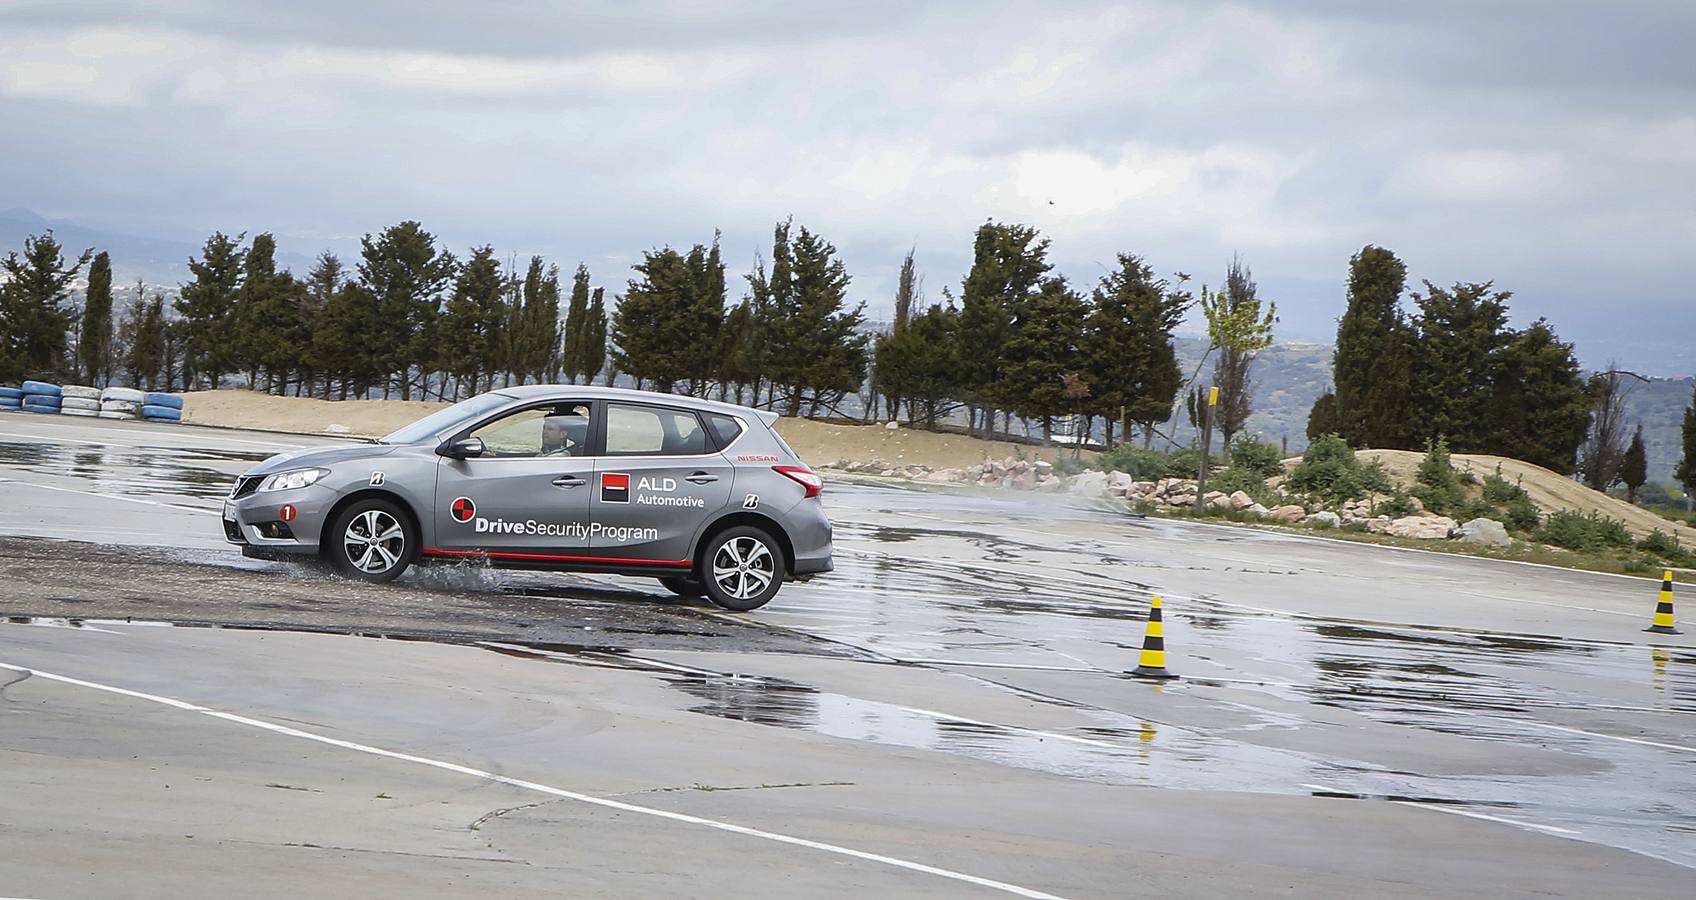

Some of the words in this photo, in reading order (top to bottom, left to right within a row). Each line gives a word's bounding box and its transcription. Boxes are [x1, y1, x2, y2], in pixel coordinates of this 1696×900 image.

[737, 455, 779, 463] NISSAN
[637, 477, 677, 492] ALD
[637, 494, 704, 508] Automotive
[283, 506, 291, 521] 1
